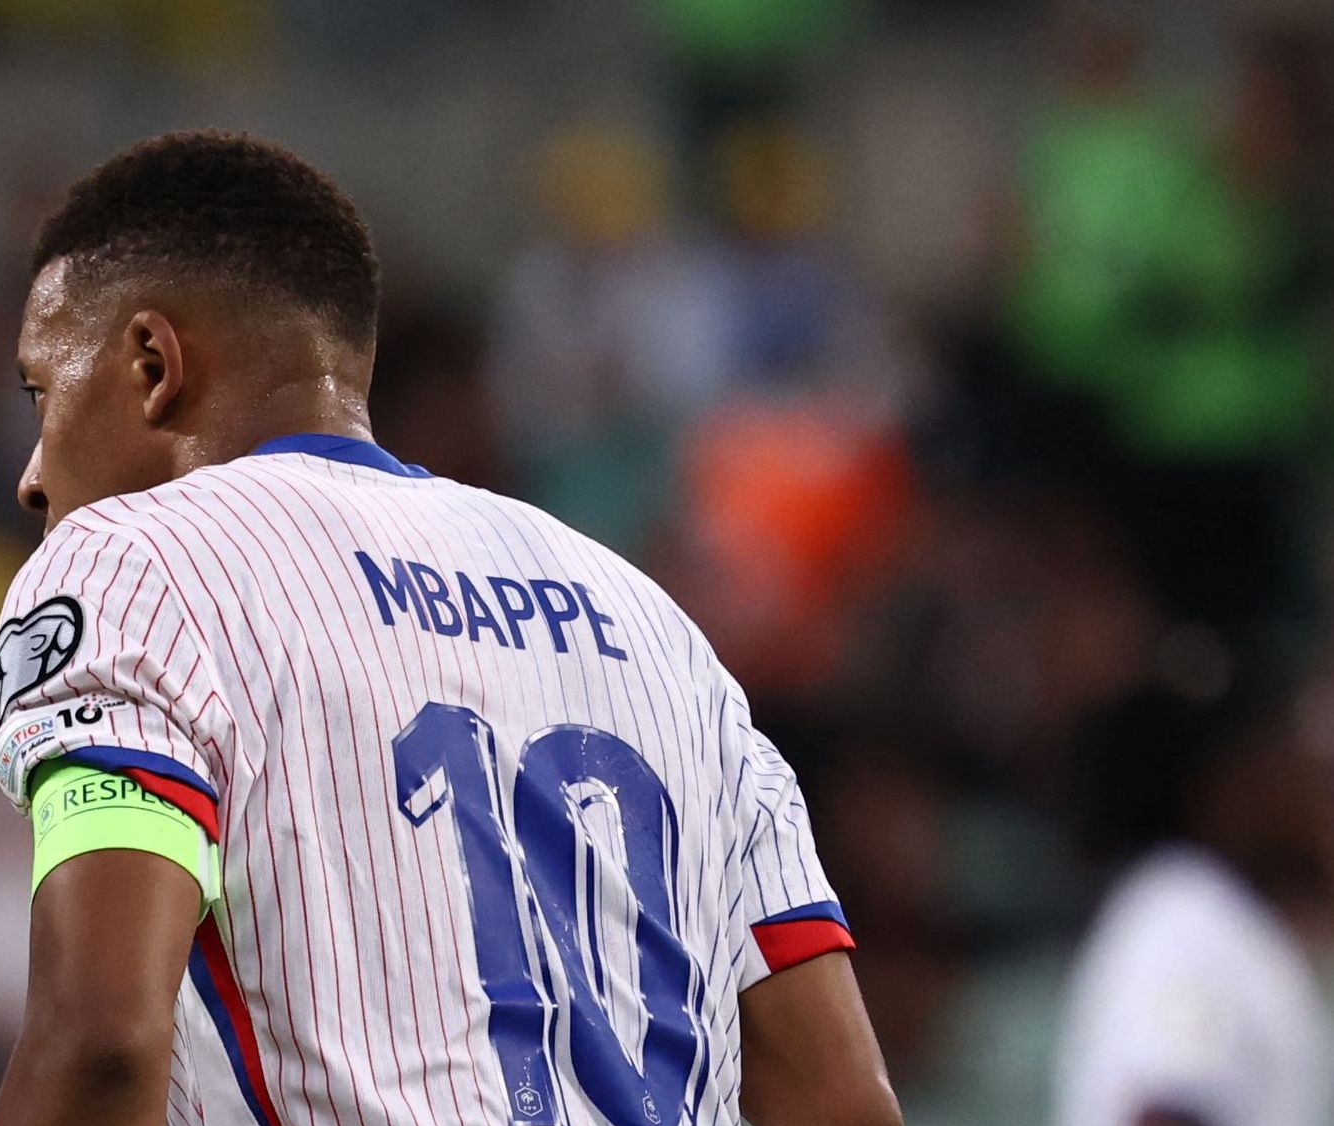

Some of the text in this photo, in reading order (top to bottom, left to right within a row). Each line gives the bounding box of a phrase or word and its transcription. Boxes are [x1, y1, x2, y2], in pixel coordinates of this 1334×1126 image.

[354, 551, 628, 662] MBAPPE
[56, 701, 126, 728] 10 YEARS
[63, 779, 186, 816] RESP
